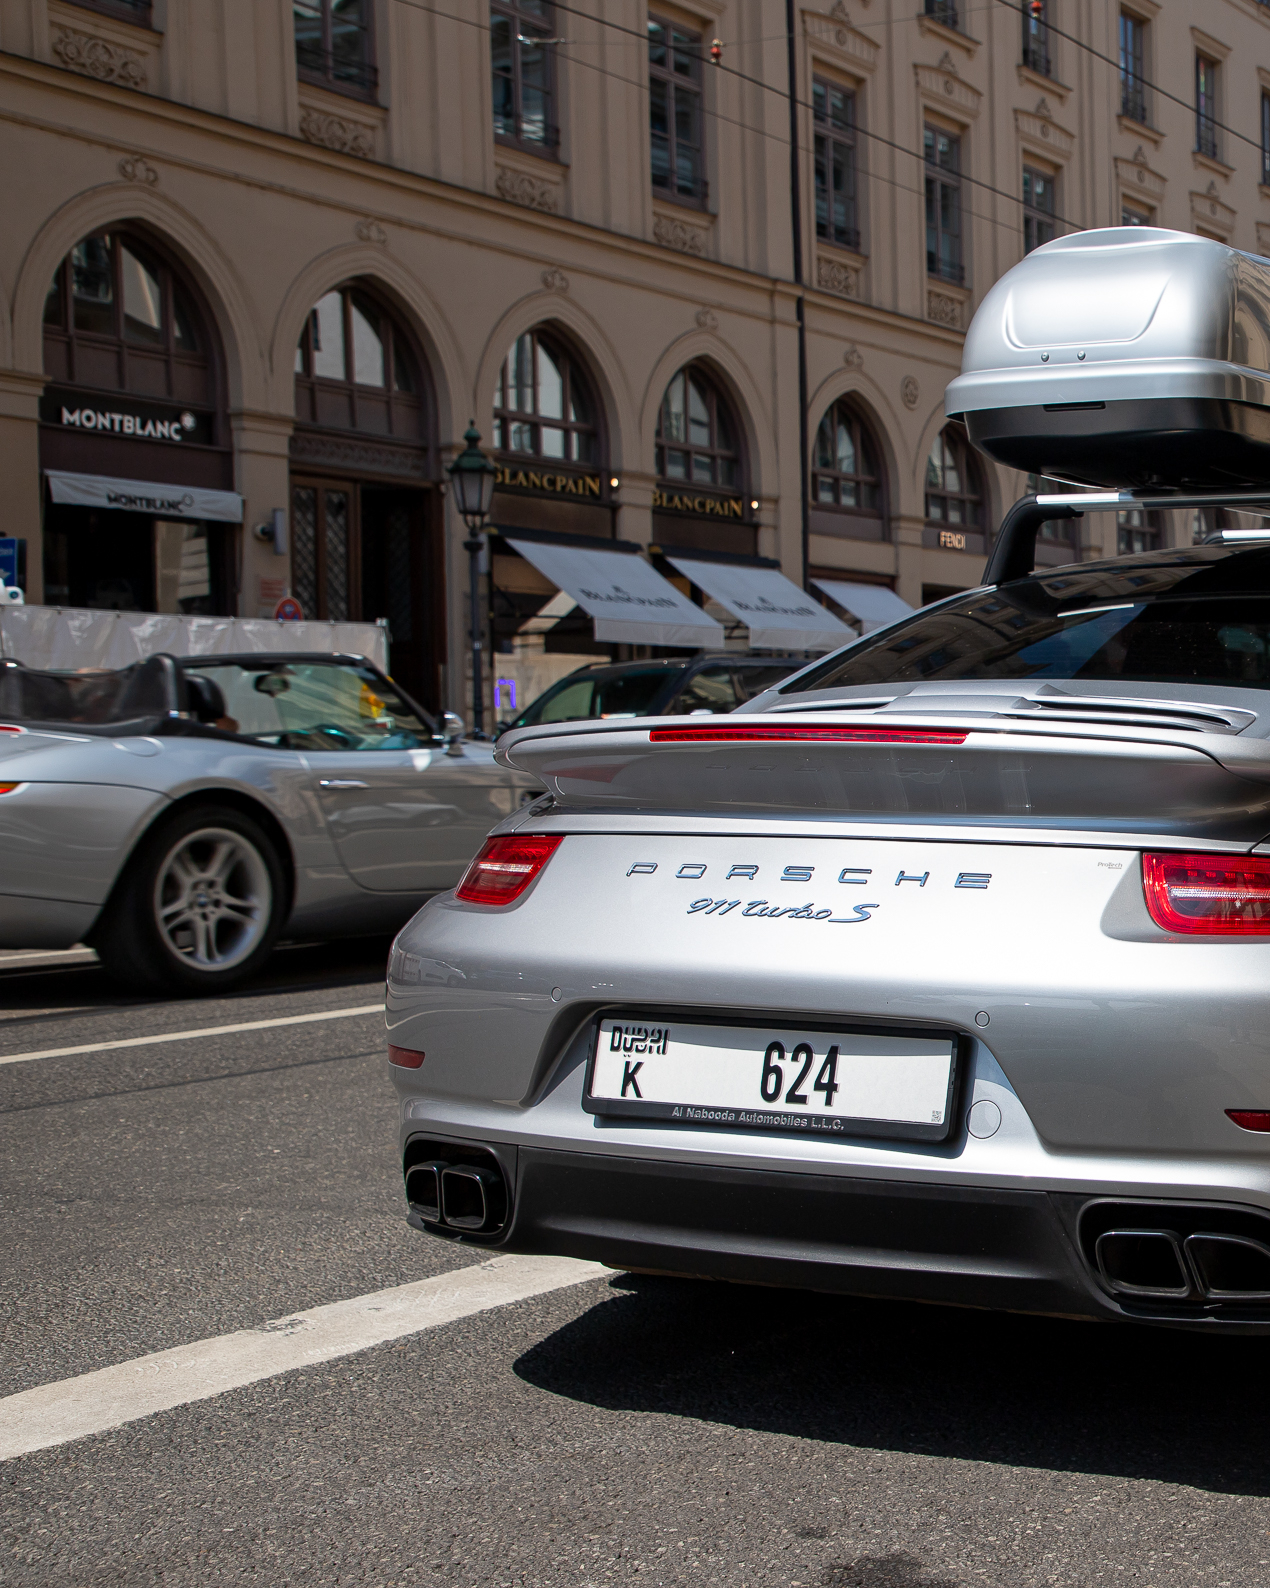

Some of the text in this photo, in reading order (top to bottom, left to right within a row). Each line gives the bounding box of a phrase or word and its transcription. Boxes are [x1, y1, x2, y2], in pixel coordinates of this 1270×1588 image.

[61, 406, 182, 441] MONTBLANC
[106, 492, 183, 514] MONTBLANC
[651, 488, 743, 517] BLANCPAIN
[940, 531, 966, 549] FENDI
[625, 861, 992, 889] PORSCHE
[687, 897, 880, 923] 911 turbo S
[621, 1040, 841, 1107] K 624
[672, 1106, 845, 1131] Al Nabooda Automobiles L.L.C.
